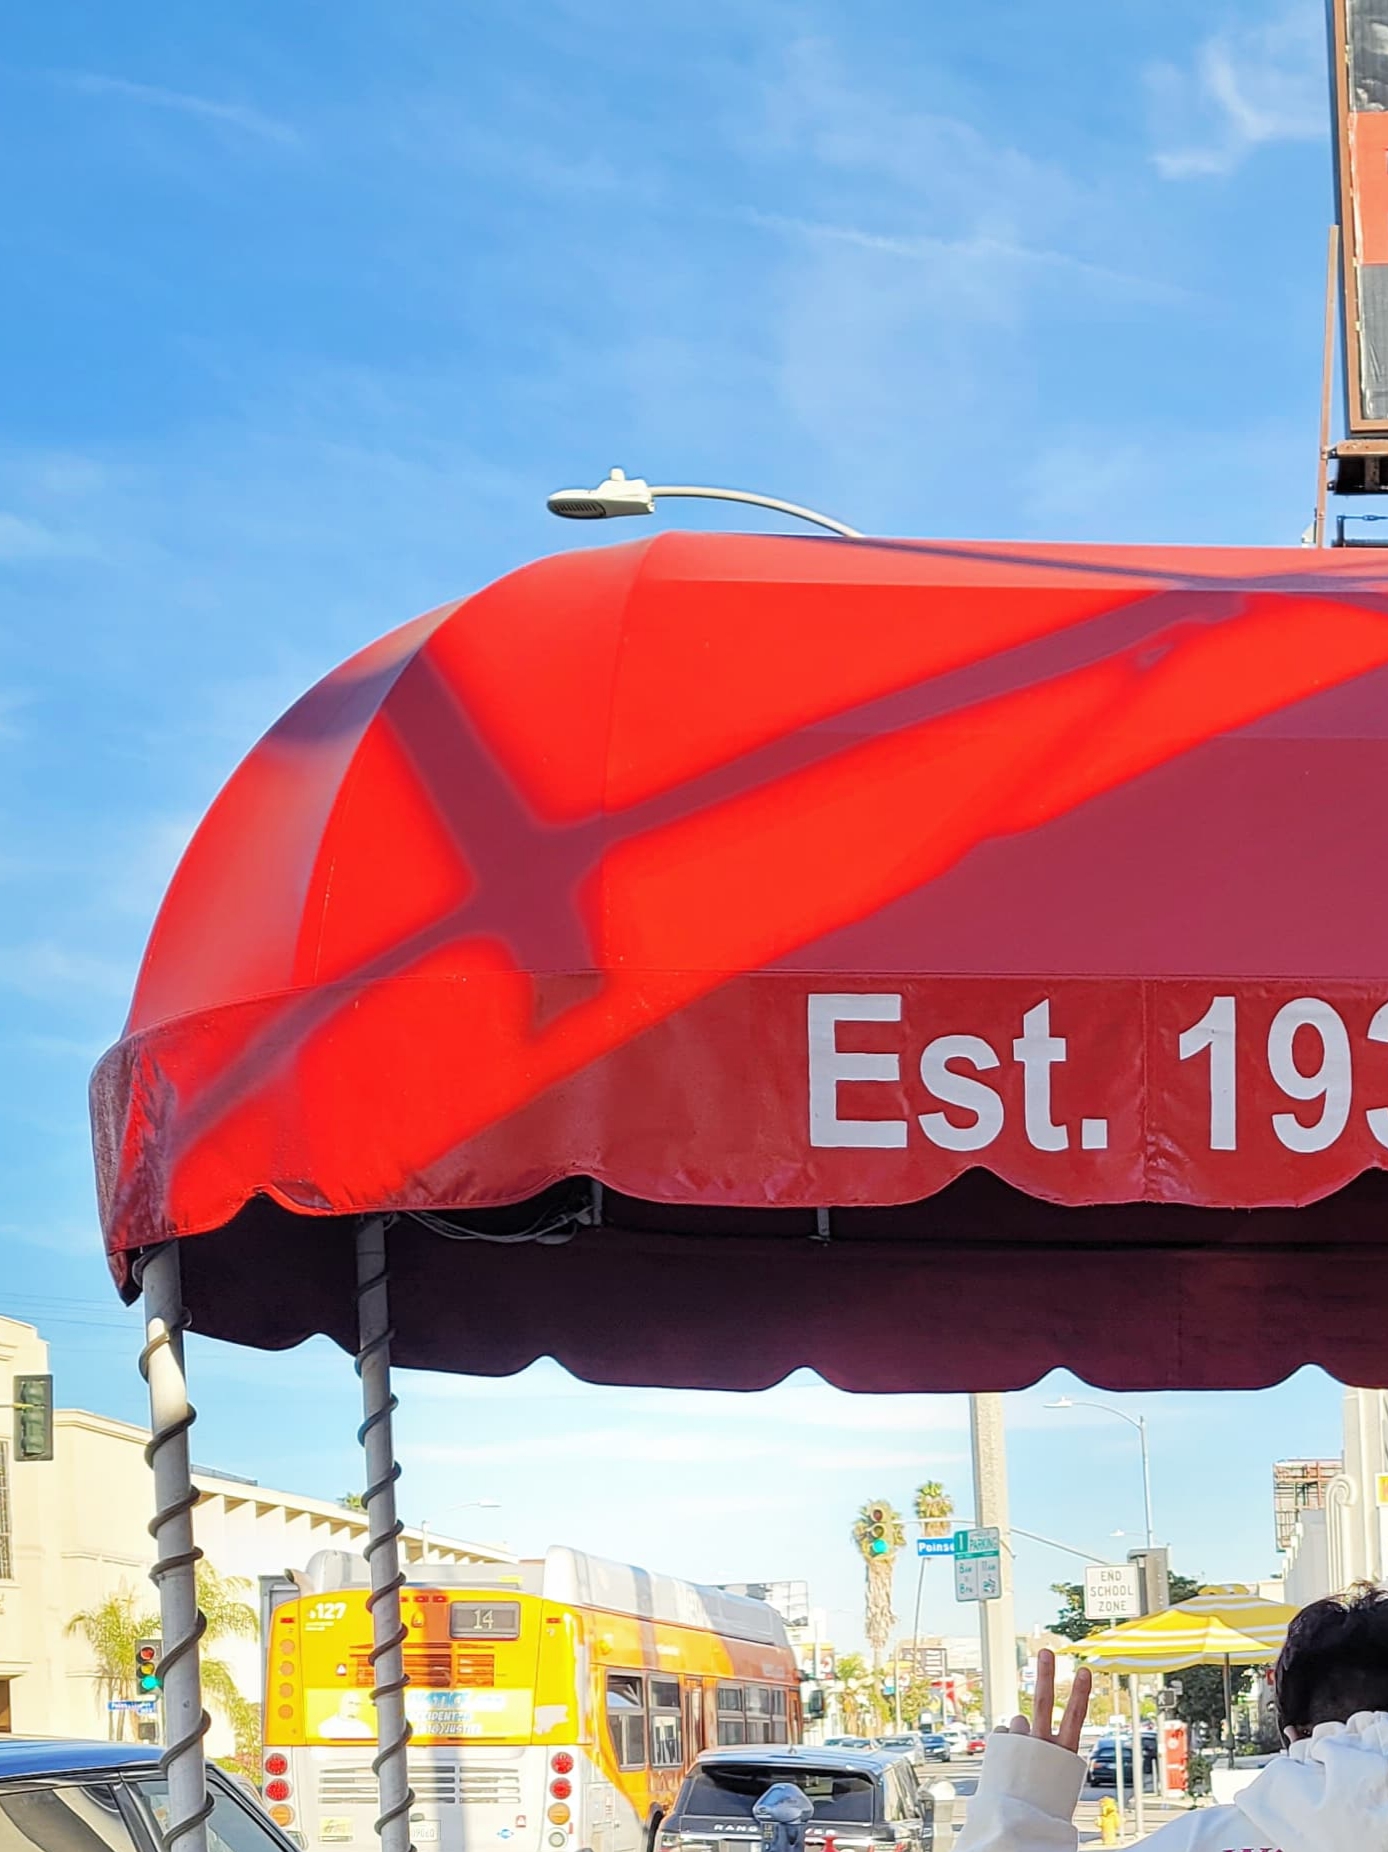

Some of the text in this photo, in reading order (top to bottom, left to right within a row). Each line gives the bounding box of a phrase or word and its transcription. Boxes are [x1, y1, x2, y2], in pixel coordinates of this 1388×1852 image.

[807, 993, 1109, 1151] Est.
[1100, 1570, 1122, 1582] END
[1089, 1584, 1134, 1598] SCHOOL
[1098, 1600, 1127, 1612] ZONE
[473, 1609, 494, 1630] 14
[714, 1824, 759, 1833] RANG
